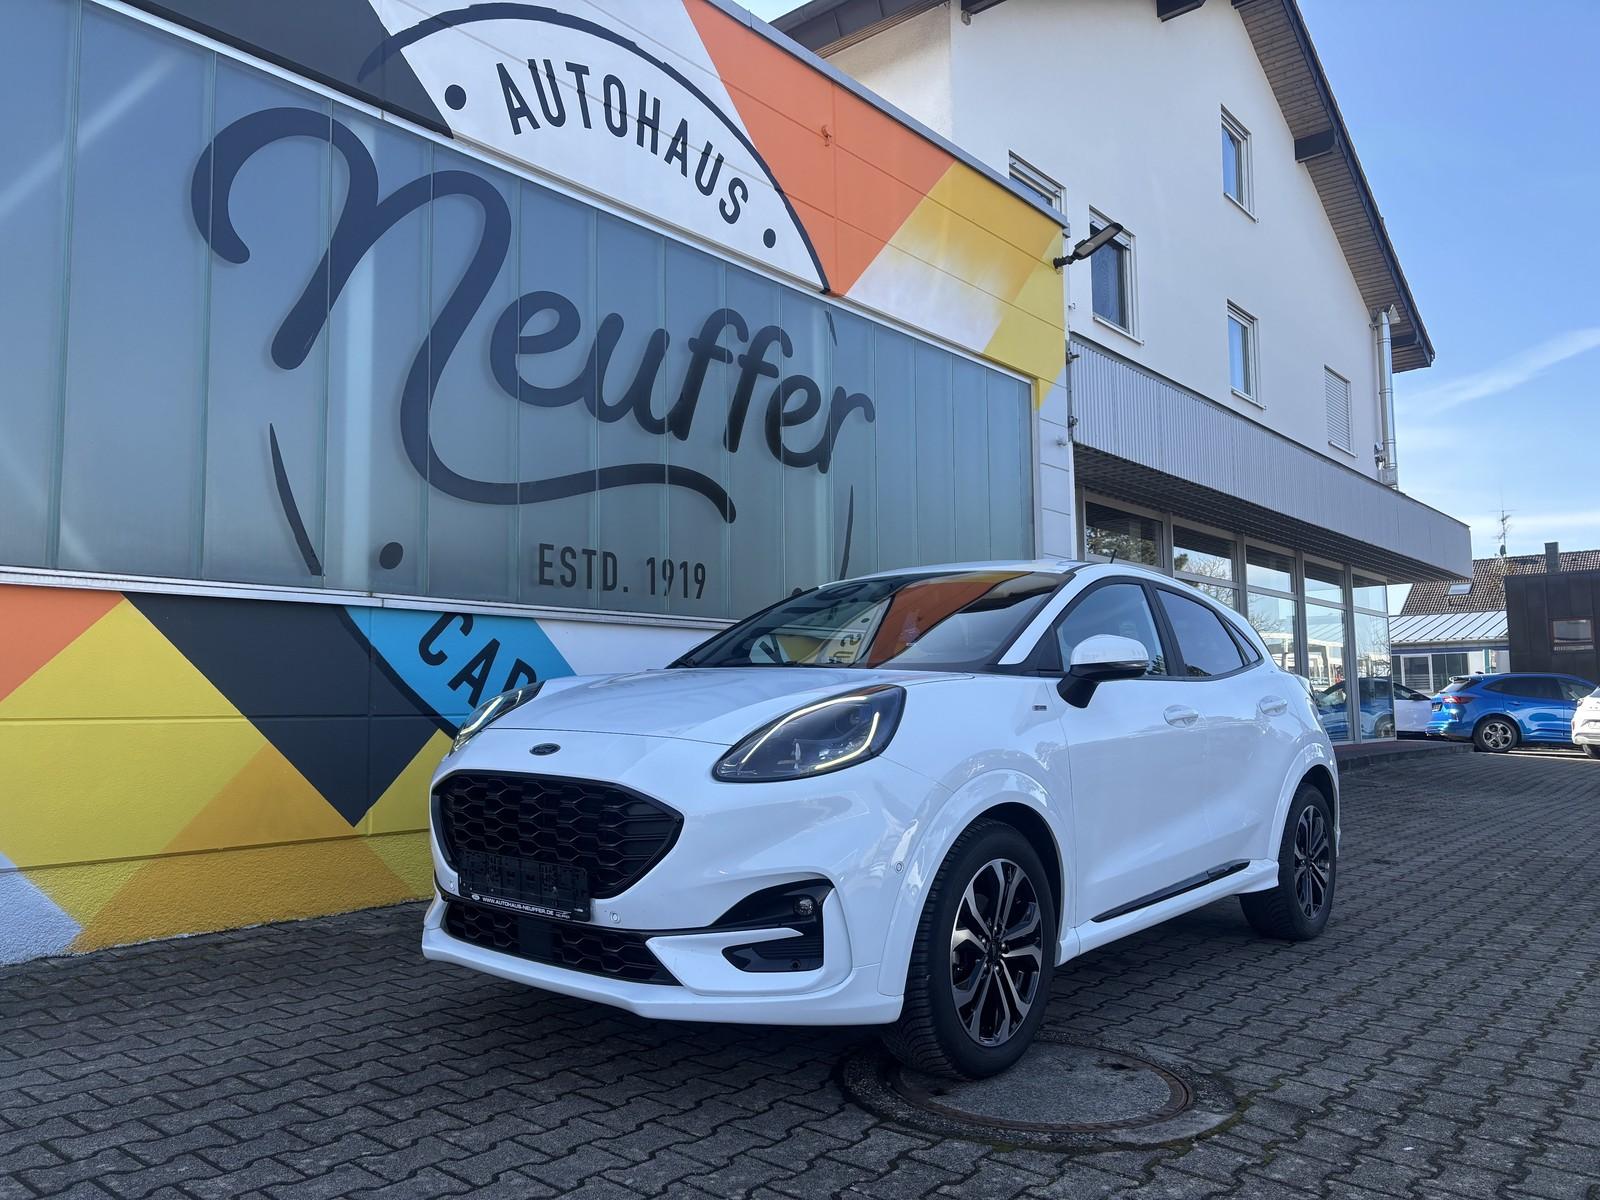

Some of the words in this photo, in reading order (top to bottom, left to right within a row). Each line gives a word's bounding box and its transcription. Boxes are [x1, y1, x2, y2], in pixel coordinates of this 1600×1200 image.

[496, 59, 749, 225] AUTOHAUS
[538, 543, 629, 593] ESTD.
[646, 557, 706, 599] 1919
